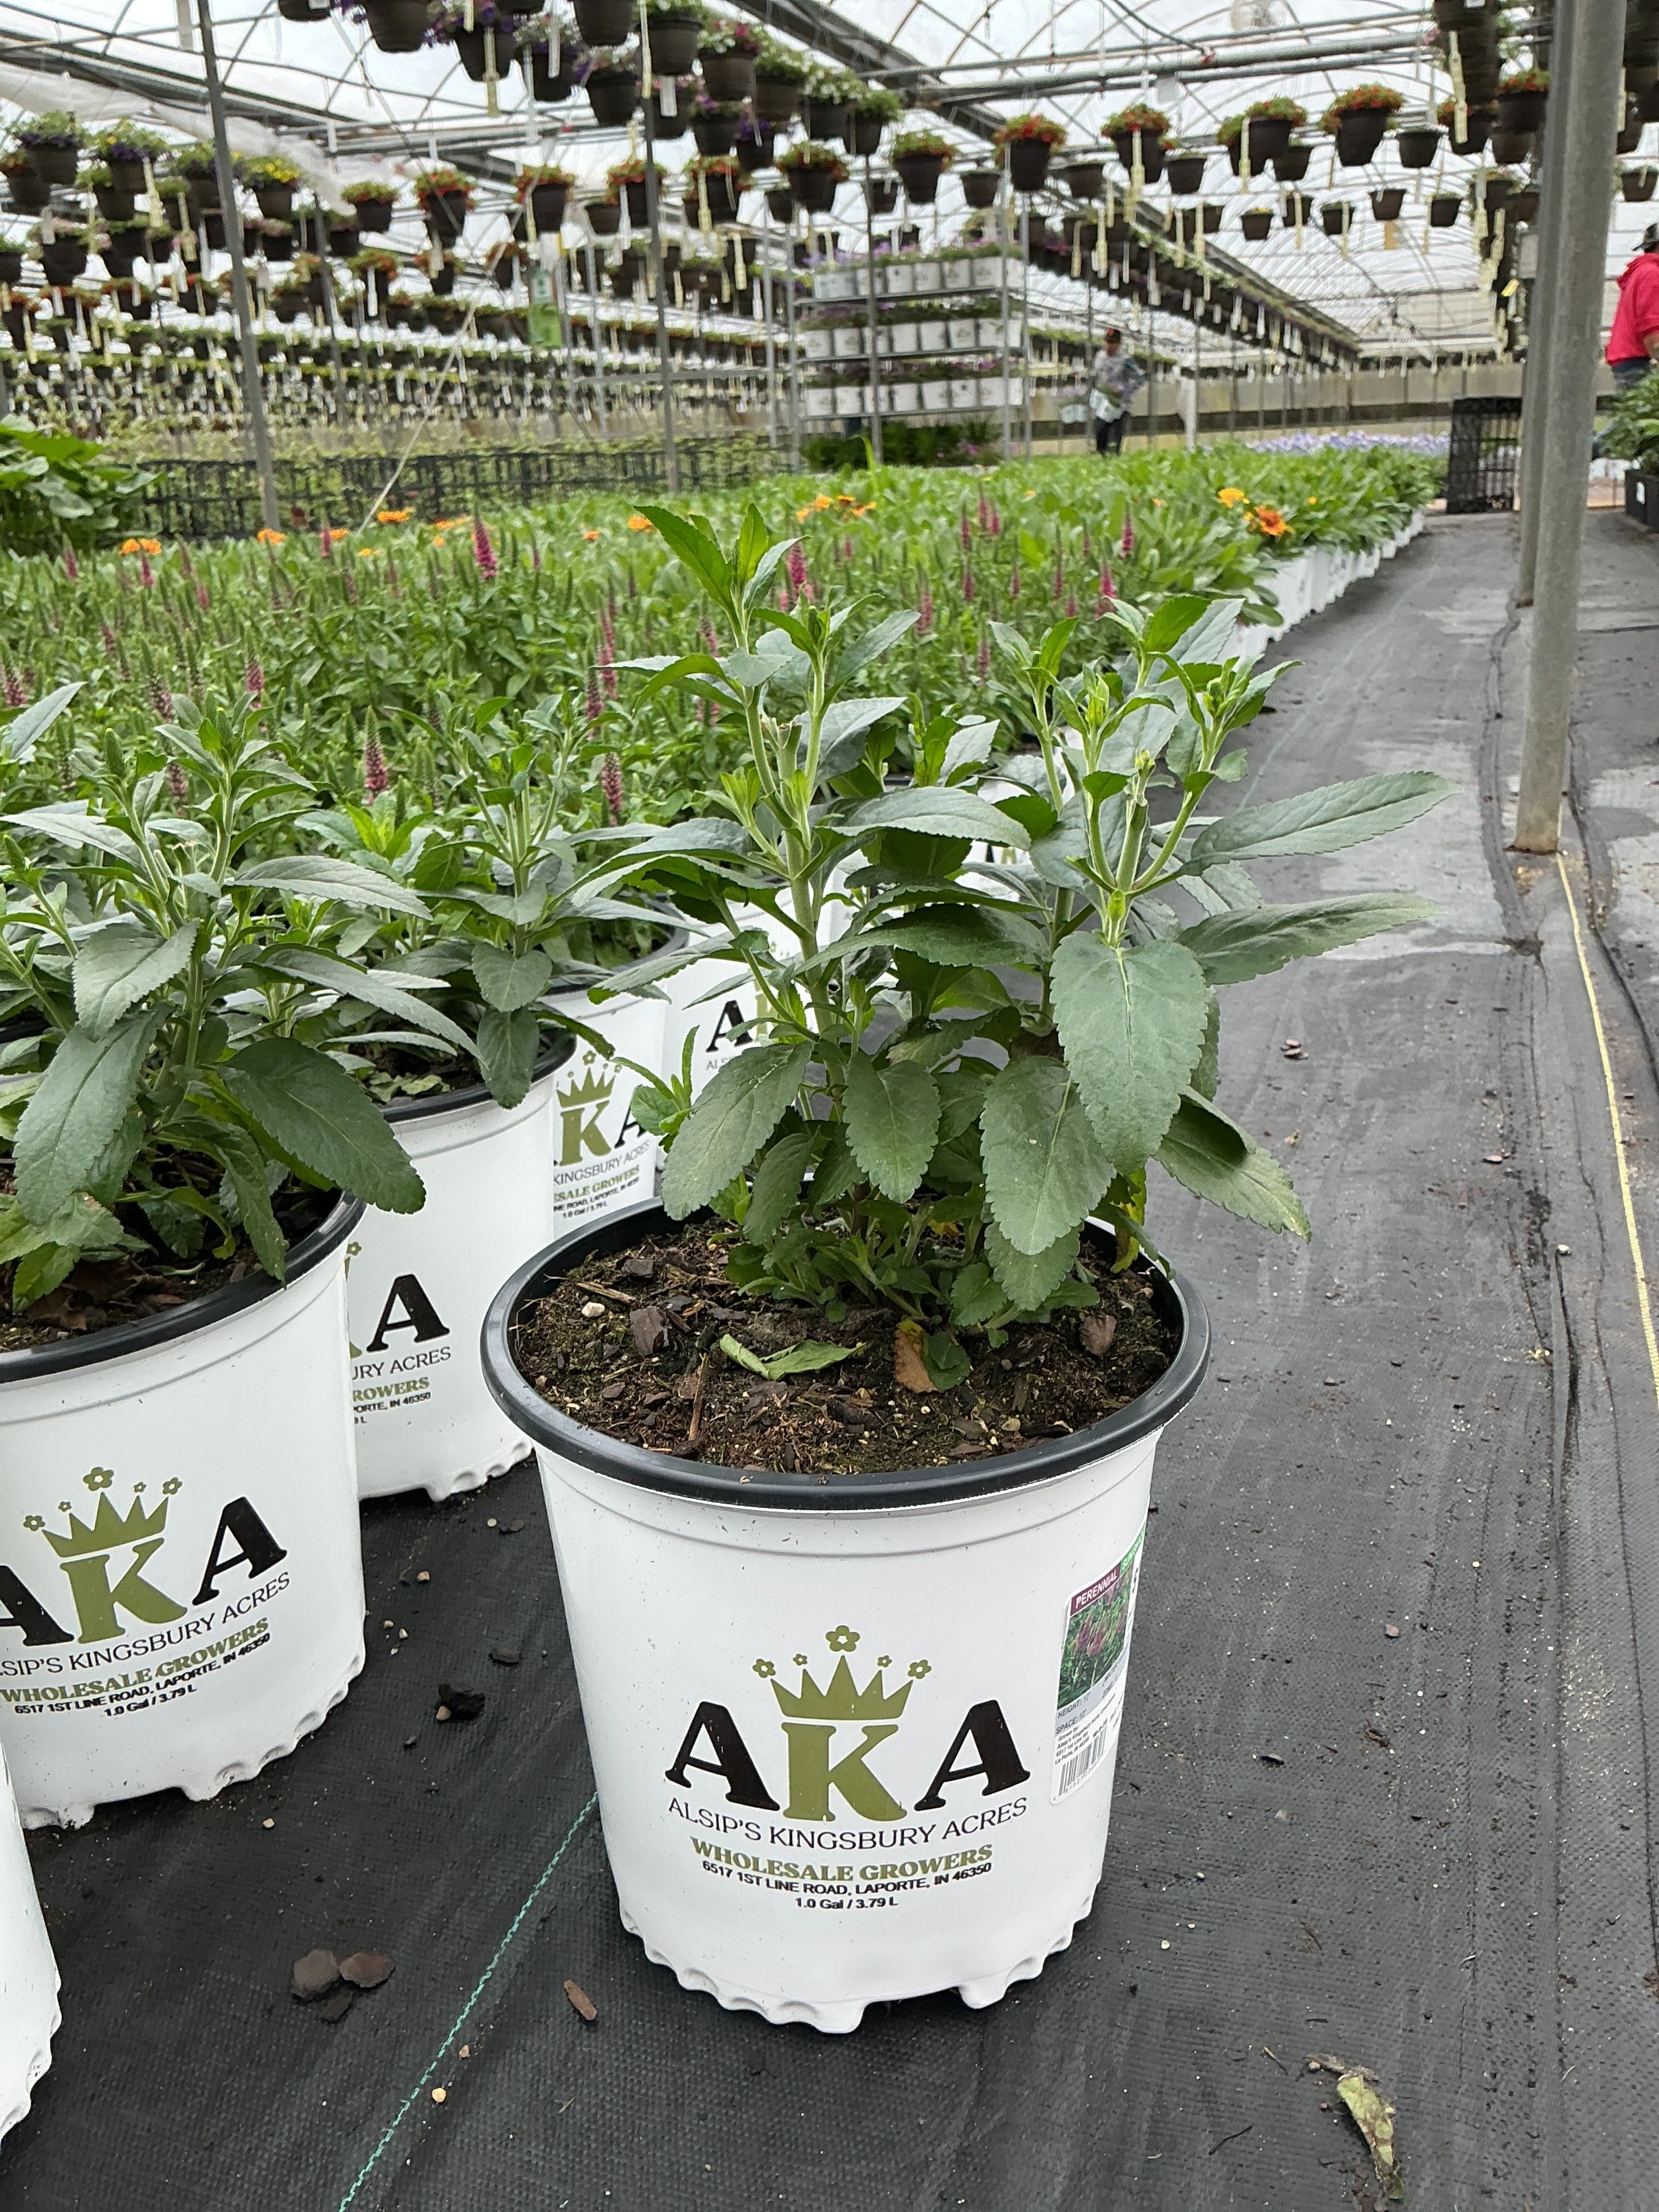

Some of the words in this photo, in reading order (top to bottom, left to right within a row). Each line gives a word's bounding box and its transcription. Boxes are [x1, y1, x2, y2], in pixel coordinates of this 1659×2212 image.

[390, 1346, 451, 1374] ACRES
[353, 1376, 430, 1402] ROWERS
[390, 1399, 400, 1408] IN
[1075, 1570, 1118, 1610] PERENNIAL
[0, 1657, 63, 1676] SIP'S
[69, 1612, 216, 1671] KINGSBURY
[222, 1571, 290, 1624] ACRES
[0, 1667, 153, 1702] WHOLESALE
[155, 1617, 269, 1678] GROWERS
[14, 1703, 44, 1714] 6517
[47, 1701, 72, 1712] 1ST
[75, 1695, 108, 1709] LINE
[223, 1651, 236, 1664] IN
[104, 1705, 125, 1717] 1.0
[159, 1687, 186, 1703] 3.79
[188, 1684, 198, 1694] L
[665, 1699, 1030, 1822] AKA
[668, 1797, 761, 1841] ALSIP'S
[770, 1824, 937, 1850] KINGSBURY
[941, 1797, 1028, 1840] ACRES
[690, 1836, 854, 1881] WHOLESALE
[859, 1843, 993, 1881] GROWERS
[702, 1860, 733, 1878] 6517
[737, 1871, 763, 1886] 1ST
[766, 1877, 800, 1893] LINE
[855, 1877, 930, 1895] LAPORTE,
[934, 1874, 949, 1886] IN
[952, 1861, 992, 1880] 46350
[795, 1897, 817, 1909] 1.0
[820, 1898, 844, 1910] Gal
[847, 1898, 853, 1910] /
[855, 1898, 887, 1909] 3.79
[889, 1895, 899, 1906] L
